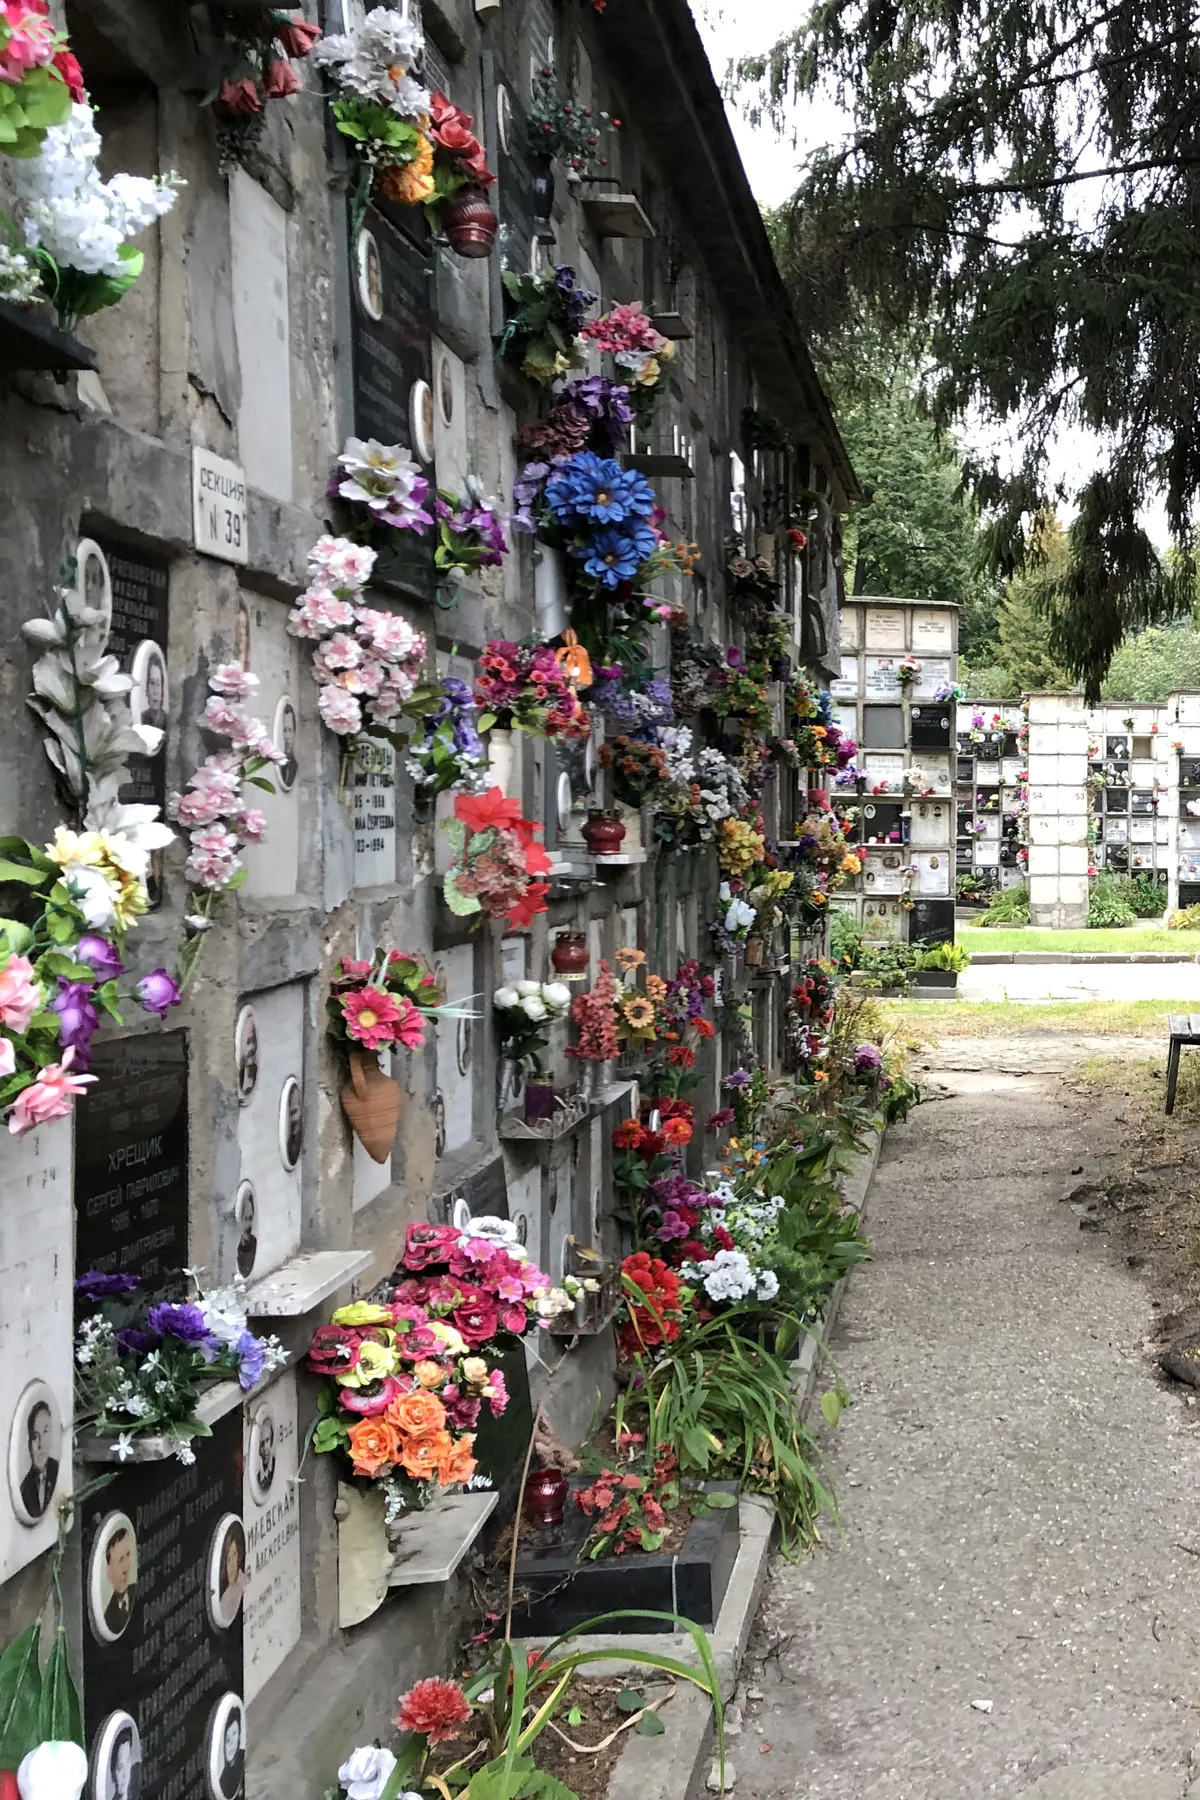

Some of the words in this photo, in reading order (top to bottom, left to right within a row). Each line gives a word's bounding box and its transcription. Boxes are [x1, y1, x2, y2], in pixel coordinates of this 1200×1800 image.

[200, 466, 245, 503] СЕКЦИЯ
[224, 508, 241, 548] 39
[1075, 792, 1085, 800] 53
[108, 1135, 162, 1173] ХРЕЩИК
[87, 1183, 123, 1217] СЕРГЕЙ
[126, 1165, 180, 1201] ГАВРИЛОВИЧ
